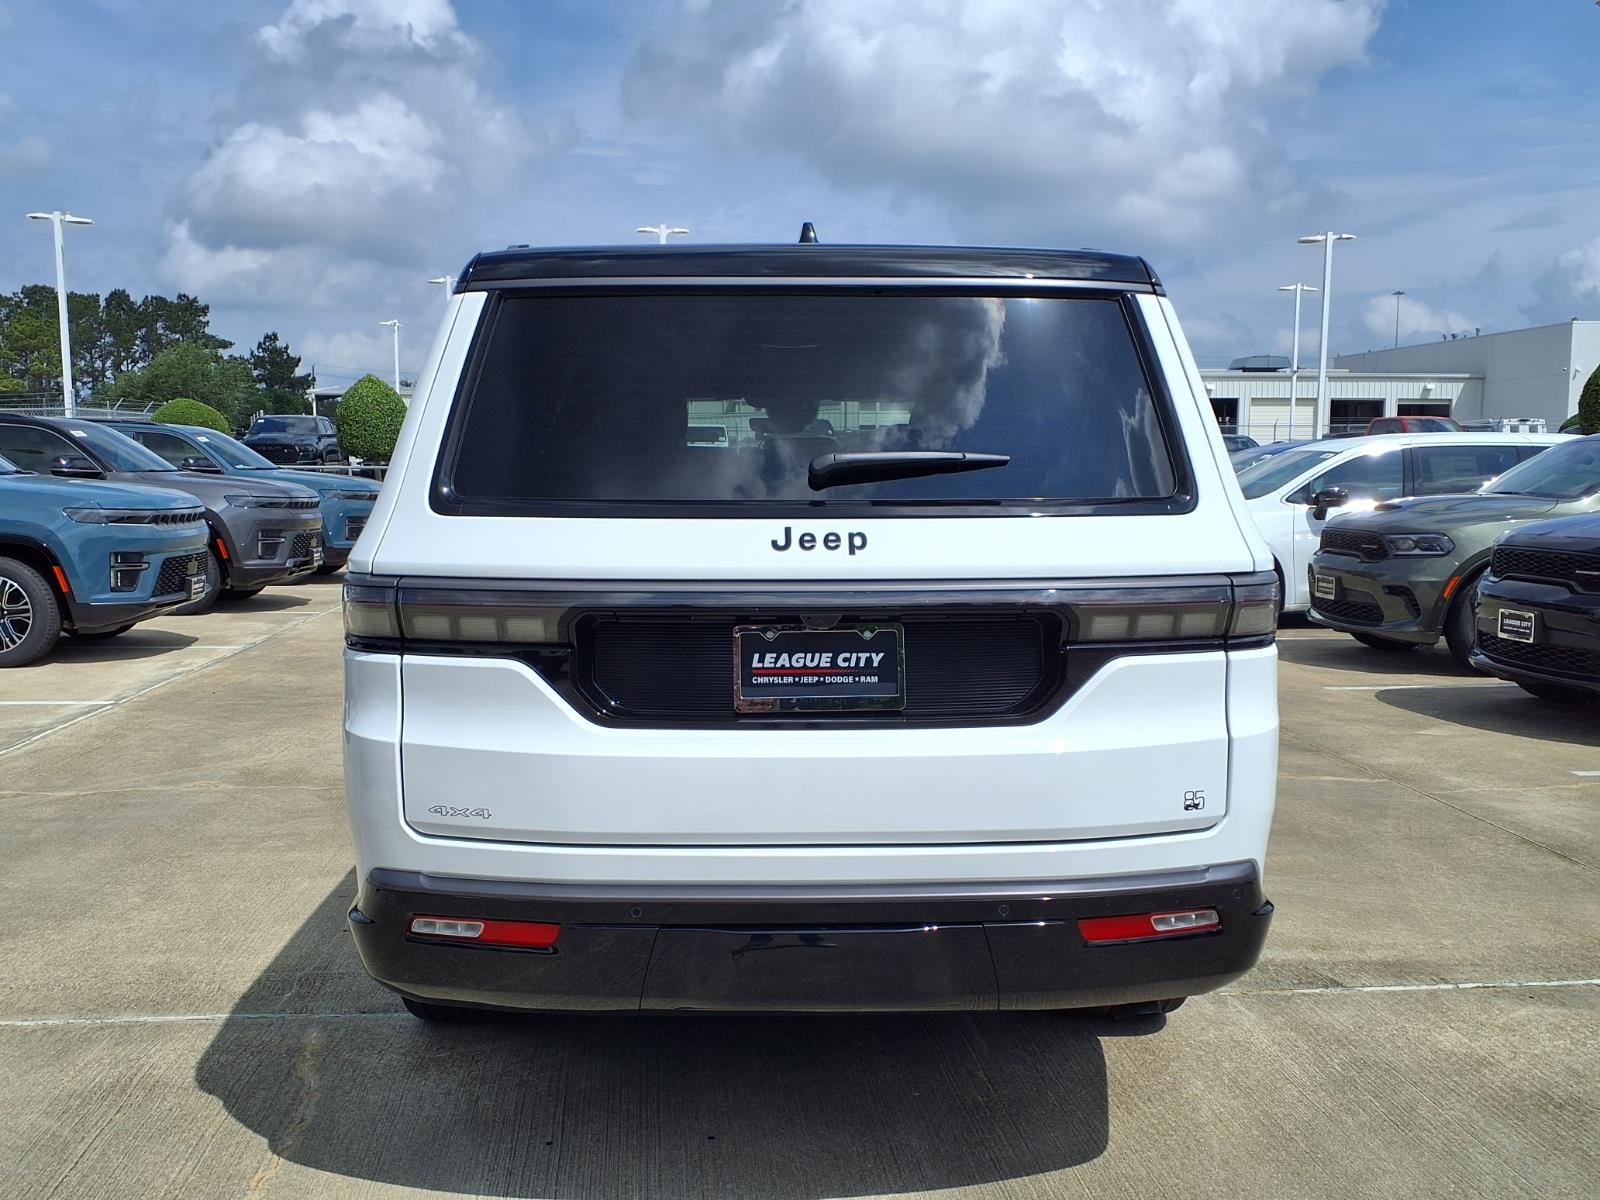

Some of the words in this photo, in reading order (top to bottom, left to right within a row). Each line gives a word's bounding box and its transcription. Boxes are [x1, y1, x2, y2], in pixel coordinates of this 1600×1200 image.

[771, 526, 868, 556] Jeep
[752, 652, 831, 668] LEAGUE
[837, 652, 885, 668] CITY
[752, 675, 795, 684] CHRYSLER
[800, 675, 819, 684] JEEP
[825, 675, 854, 684] DODGE
[860, 675, 879, 683] RAM
[428, 805, 492, 819] 4x4
